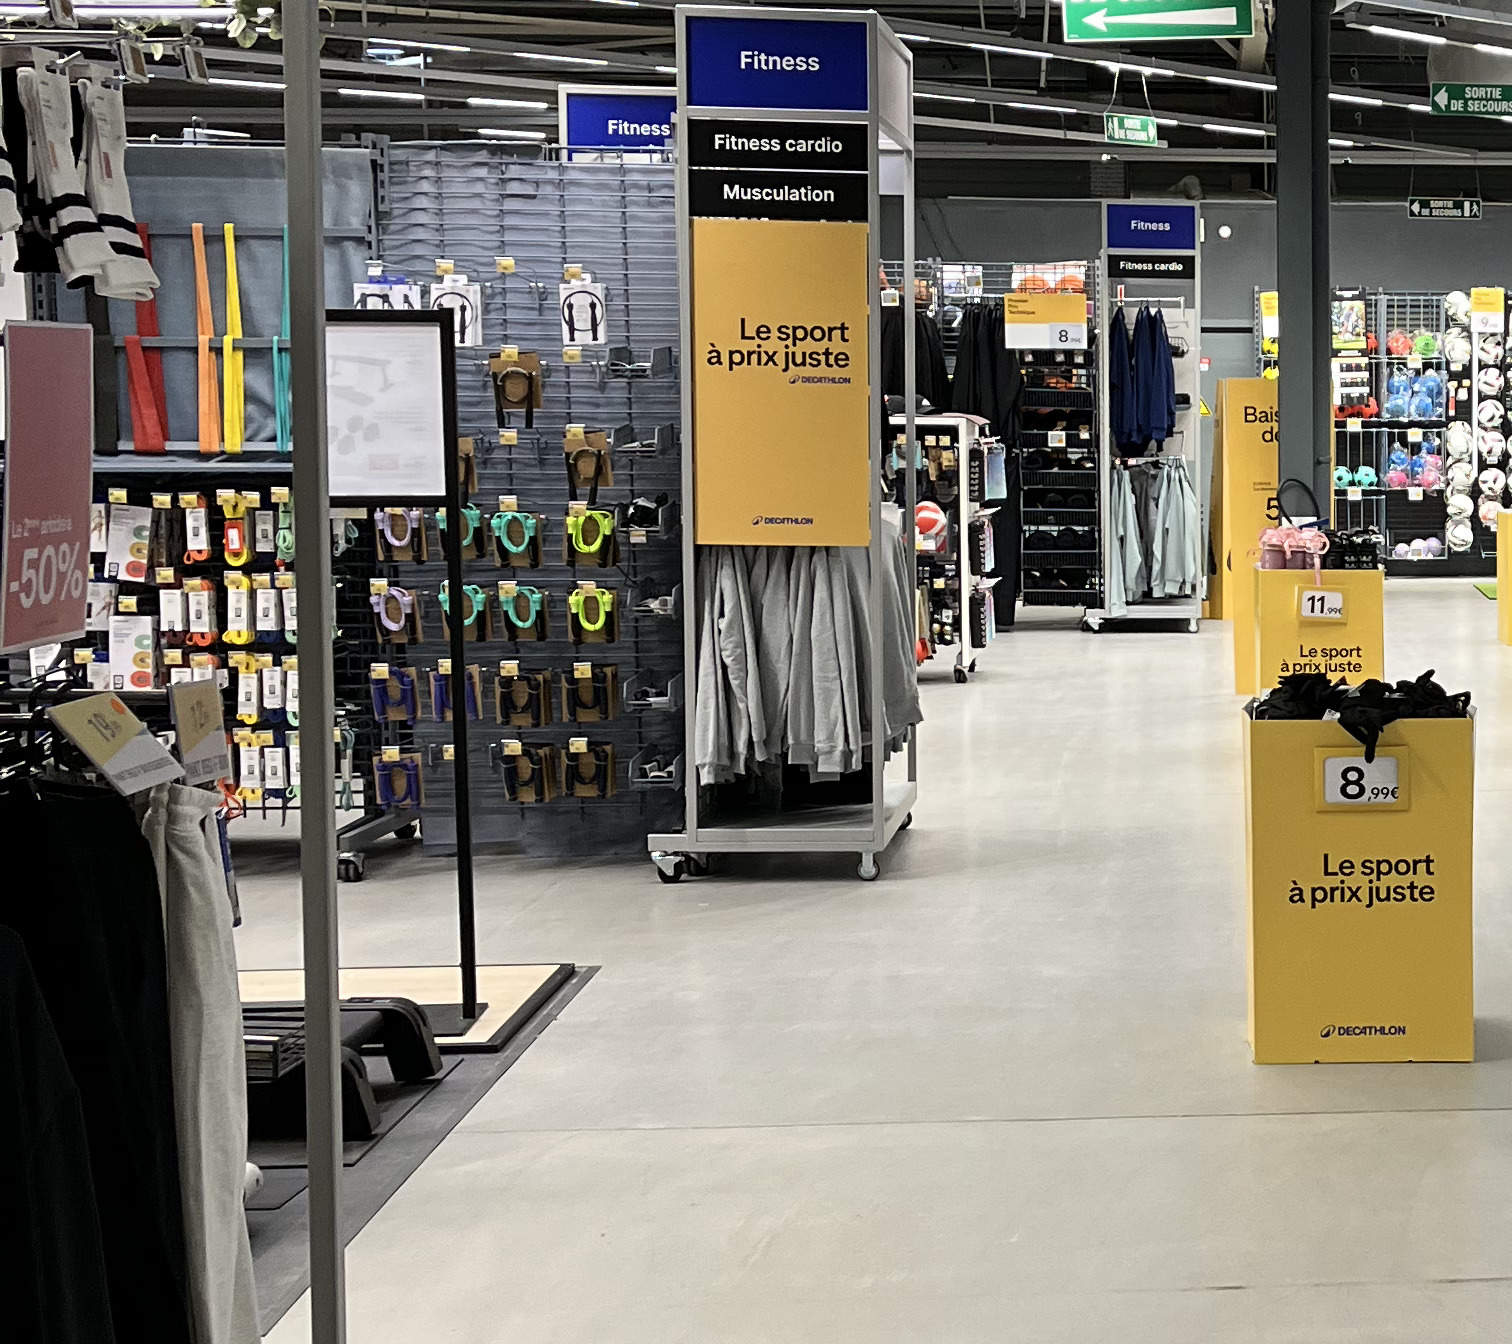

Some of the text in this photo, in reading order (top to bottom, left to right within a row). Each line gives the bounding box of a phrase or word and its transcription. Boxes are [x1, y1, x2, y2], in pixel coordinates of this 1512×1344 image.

[740, 50, 820, 71] Fitness
[1464, 86, 1502, 99] SORTIE
[1450, 99, 1464, 111] DE
[607, 119, 671, 136] Fitness
[714, 133, 843, 153] Fitness cardio
[723, 184, 835, 202] Musculation
[1130, 219, 1170, 231] Fitness
[1120, 261, 1183, 271] Fitness cardio
[740, 317, 850, 347] Le sport
[706, 342, 850, 373] à prix juste
[801, 376, 851, 384] DECATHLON
[764, 517, 813, 525] DECATHLON
[9, 541, 83, 609] -50%
[1300, 644, 1362, 661] Le sport
[1280, 658, 1362, 674] à prix juste
[1339, 766, 1399, 802] 8,99€
[1323, 853, 1435, 882] Le sport
[1288, 878, 1435, 909] à prix juste
[1338, 1026, 1406, 1036] DECATHLON
